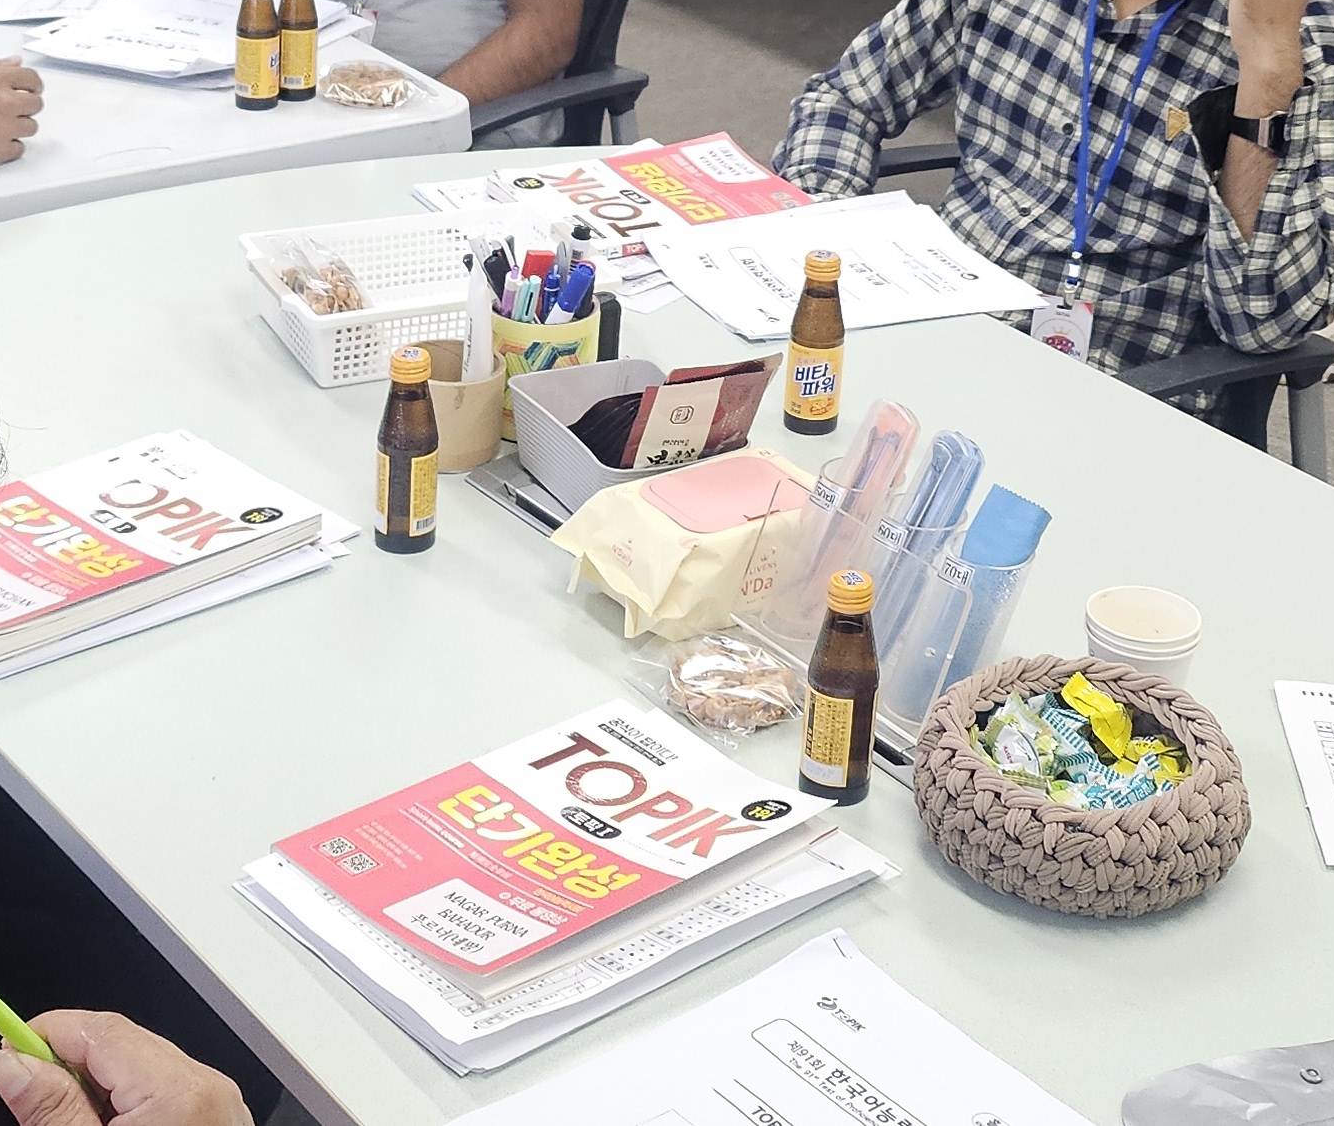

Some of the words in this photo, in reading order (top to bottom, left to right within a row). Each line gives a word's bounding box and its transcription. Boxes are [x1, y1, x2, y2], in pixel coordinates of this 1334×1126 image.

[537, 168, 662, 237] TOPIK
[795, 363, 830, 382] 비타
[801, 375, 836, 396] 파워
[878, 524, 902, 544] 60대
[944, 562, 969, 585] 70대
[609, 717, 642, 739] 공식이
[527, 731, 768, 858] TOPIK
[573, 812, 601, 831] 토픽
[438, 785, 642, 898] 단기완성
[437, 909, 495, 941] BAHADUR
[444, 891, 488, 920] MAGAR
[485, 913, 528, 939] PURNA
[835, 1008, 866, 1031] TOPIK
[787, 1040, 826, 1071] 제91회
[789, 1057, 803, 1070] The
[819, 1081, 835, 1095] Test
[835, 1093, 846, 1102] of
